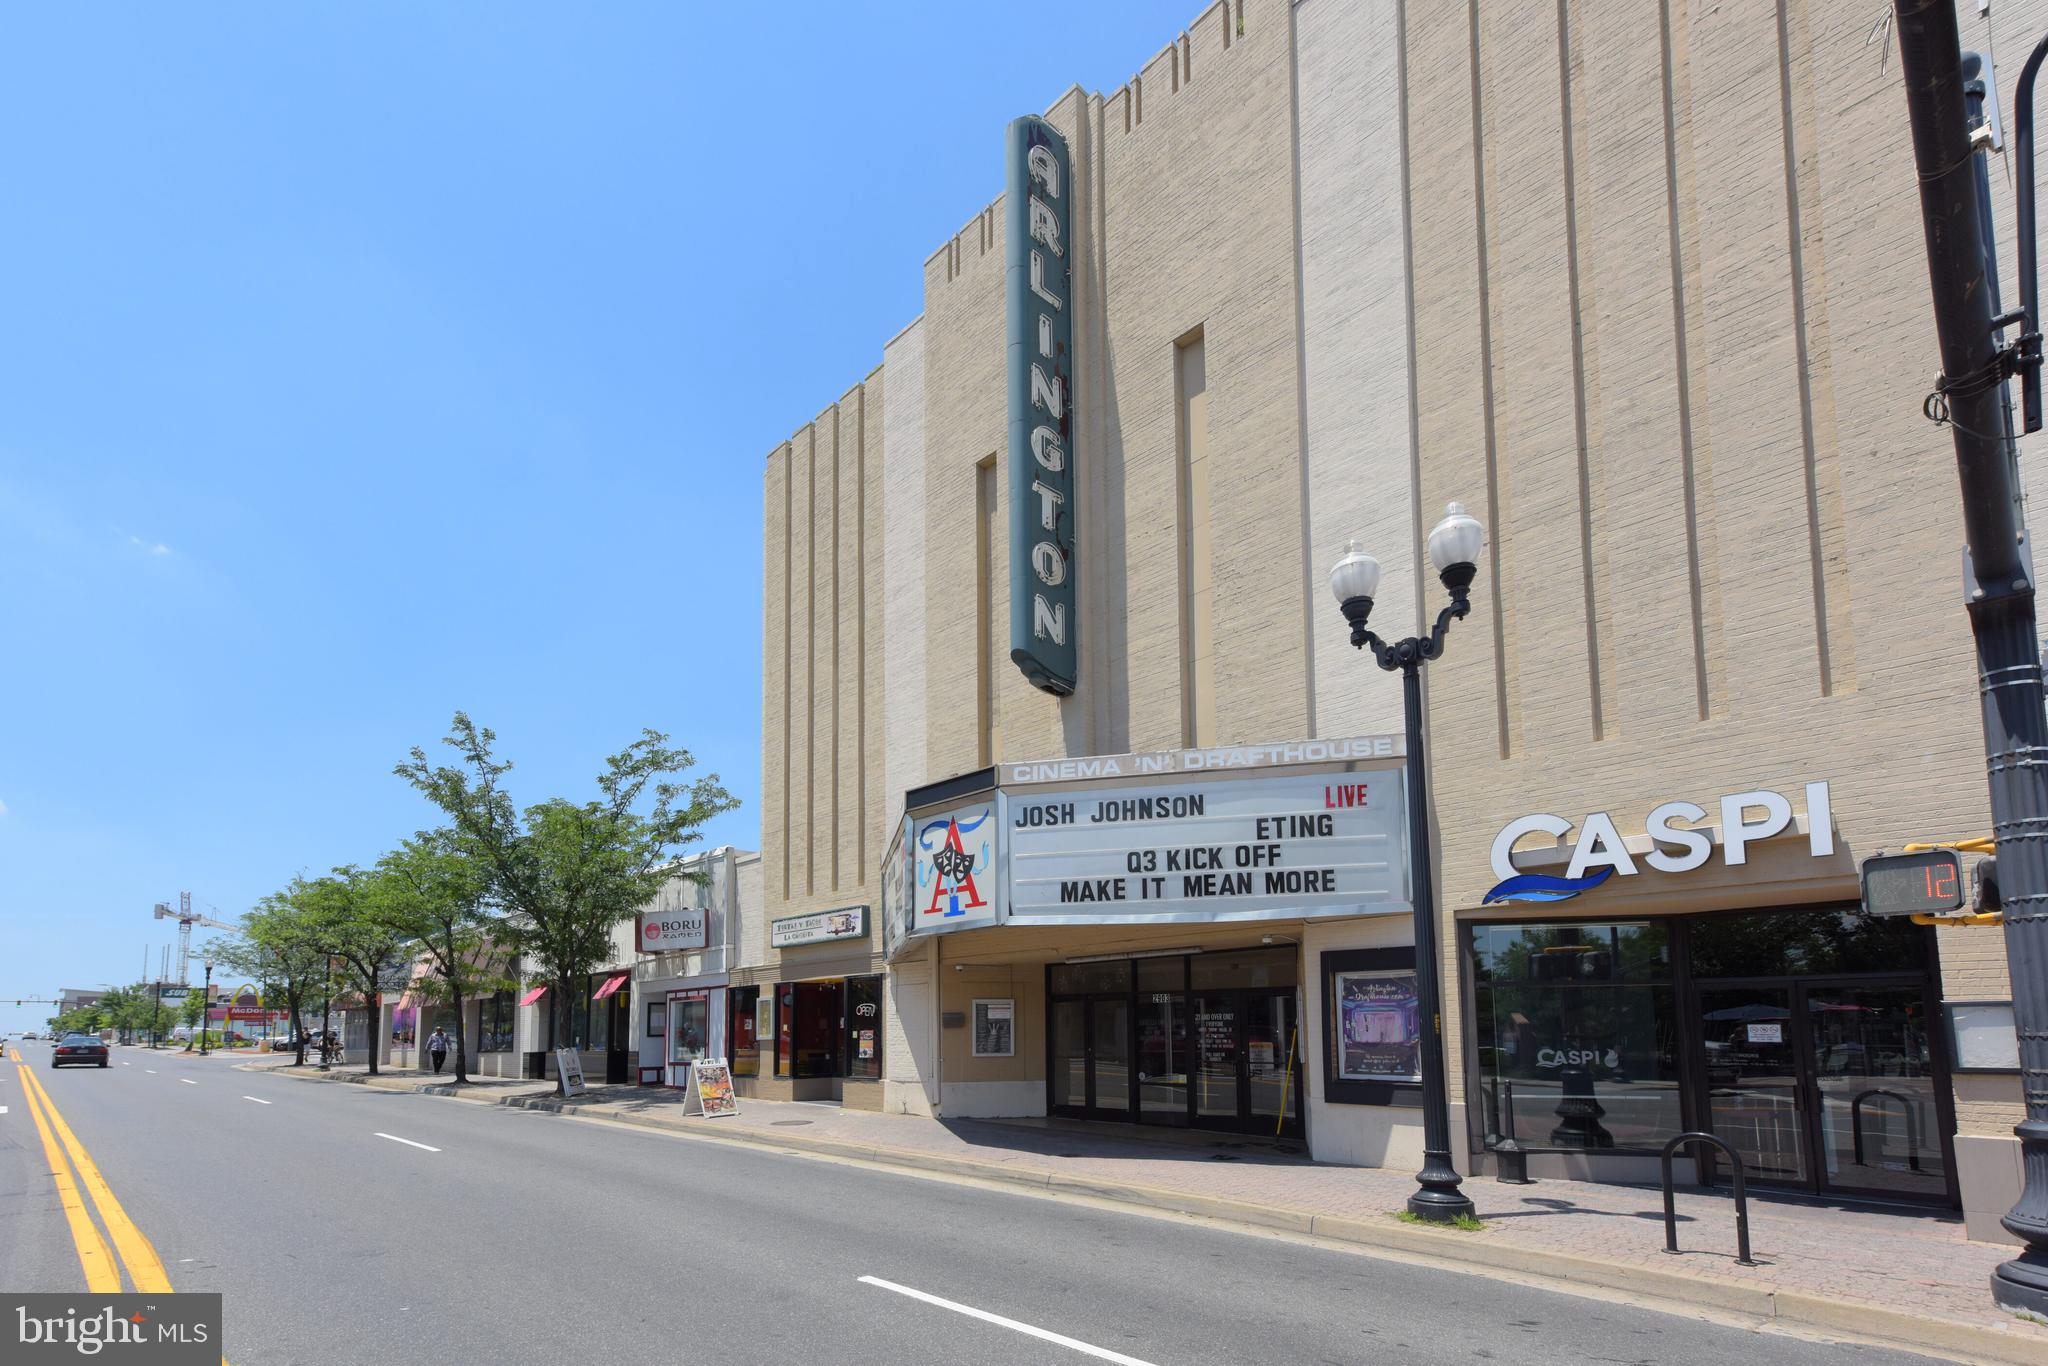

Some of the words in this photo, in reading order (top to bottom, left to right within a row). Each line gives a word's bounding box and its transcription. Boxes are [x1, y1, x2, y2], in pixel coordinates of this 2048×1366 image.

[1028, 144, 1067, 646] ARLINGTON
[1013, 759, 1121, 781] CINEMA
[1184, 738, 1393, 769] DRAFTHOUSE
[1015, 803, 1075, 827] JOSH
[1091, 794, 1204, 823] JOHNSON
[1325, 784, 1368, 809] LIVE
[1256, 814, 1333, 840] ETING
[1490, 781, 1835, 880] CASPI
[1127, 850, 1157, 873] Q3
[1167, 847, 1223, 872] KICK
[1235, 844, 1281, 867] OFF
[1061, 878, 1125, 902] MAKE
[1142, 877, 1165, 899] IT
[1184, 872, 1252, 897] MEAN
[1265, 869, 1335, 894] MORE
[1926, 864, 1955, 898] 12
[661, 920, 702, 931] BORU
[856, 1004, 875, 1016] OPEN
[1536, 1048, 1601, 1067] CASPI
